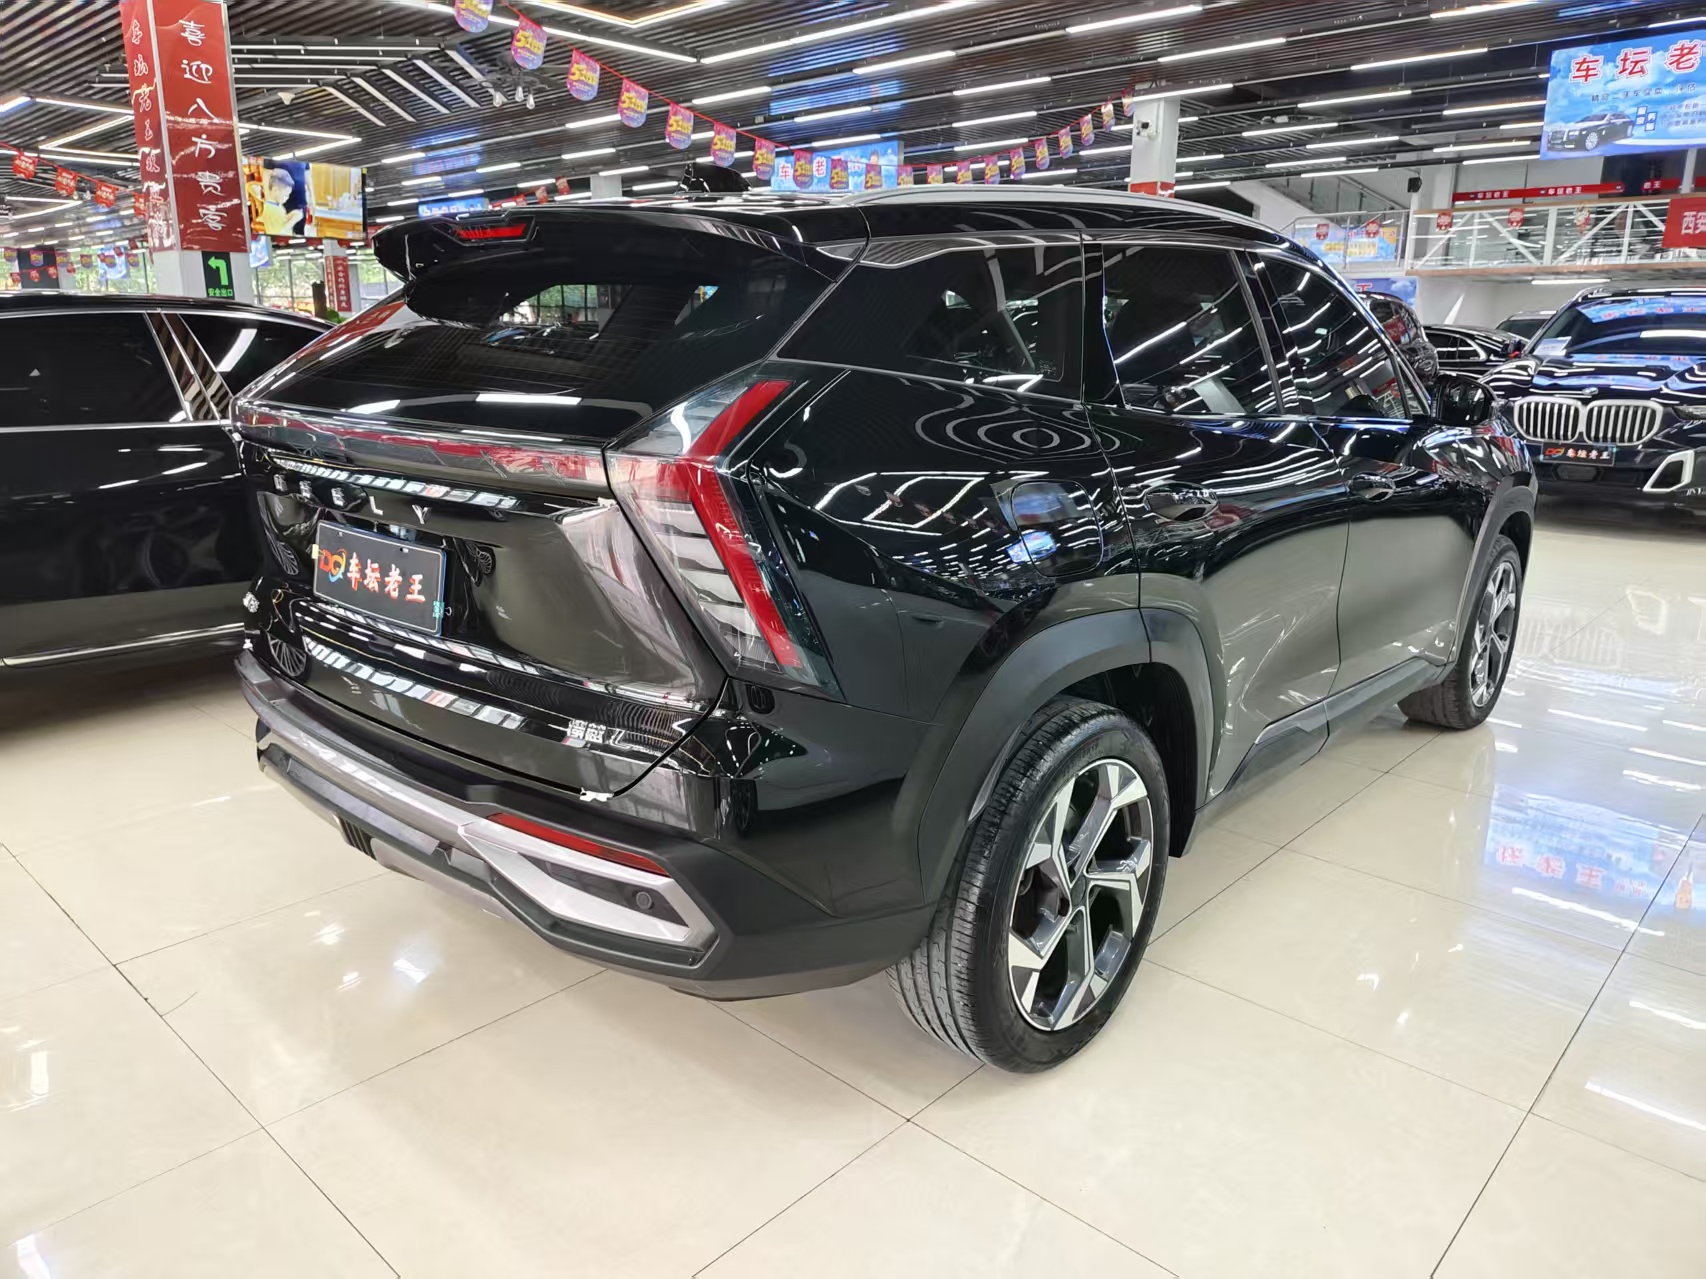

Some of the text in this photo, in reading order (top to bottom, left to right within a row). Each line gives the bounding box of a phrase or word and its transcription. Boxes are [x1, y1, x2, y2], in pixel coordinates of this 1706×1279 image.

[179, 20, 227, 231] 喜迎八方贵客
[208, 288, 233, 297] 安全出口
[346, 552, 426, 604] 车坛老王
